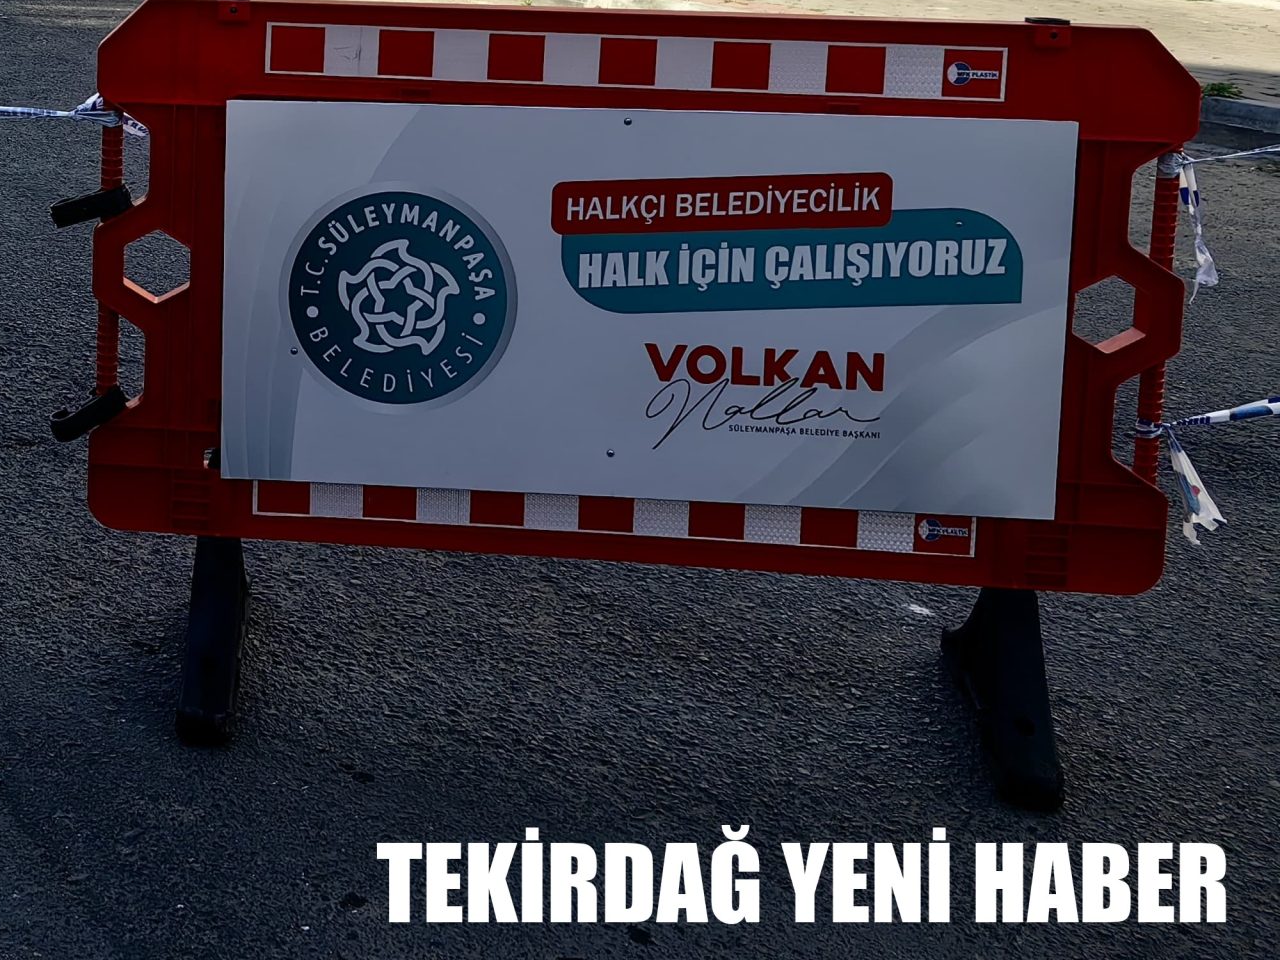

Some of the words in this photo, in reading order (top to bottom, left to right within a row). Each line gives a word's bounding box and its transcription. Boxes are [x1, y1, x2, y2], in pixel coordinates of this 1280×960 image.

[566, 195, 666, 225] HALKÇI
[676, 182, 881, 217] BELEDİYECİLİK
[300, 259, 330, 297] T.C.
[318, 203, 496, 301] SÜLEYMANPAŞA
[578, 249, 670, 288] HALK
[678, 243, 755, 291] İÇİN
[765, 238, 1008, 289] ÇALIŞIYORUZ
[309, 326, 484, 393] BELEDİYESİ
[644, 342, 885, 392] VOLKAN
[728, 423, 797, 435] SÜLEYMANPAŞA
[800, 426, 840, 437] BELEDİYE
[842, 430, 881, 440] BAŞKANI
